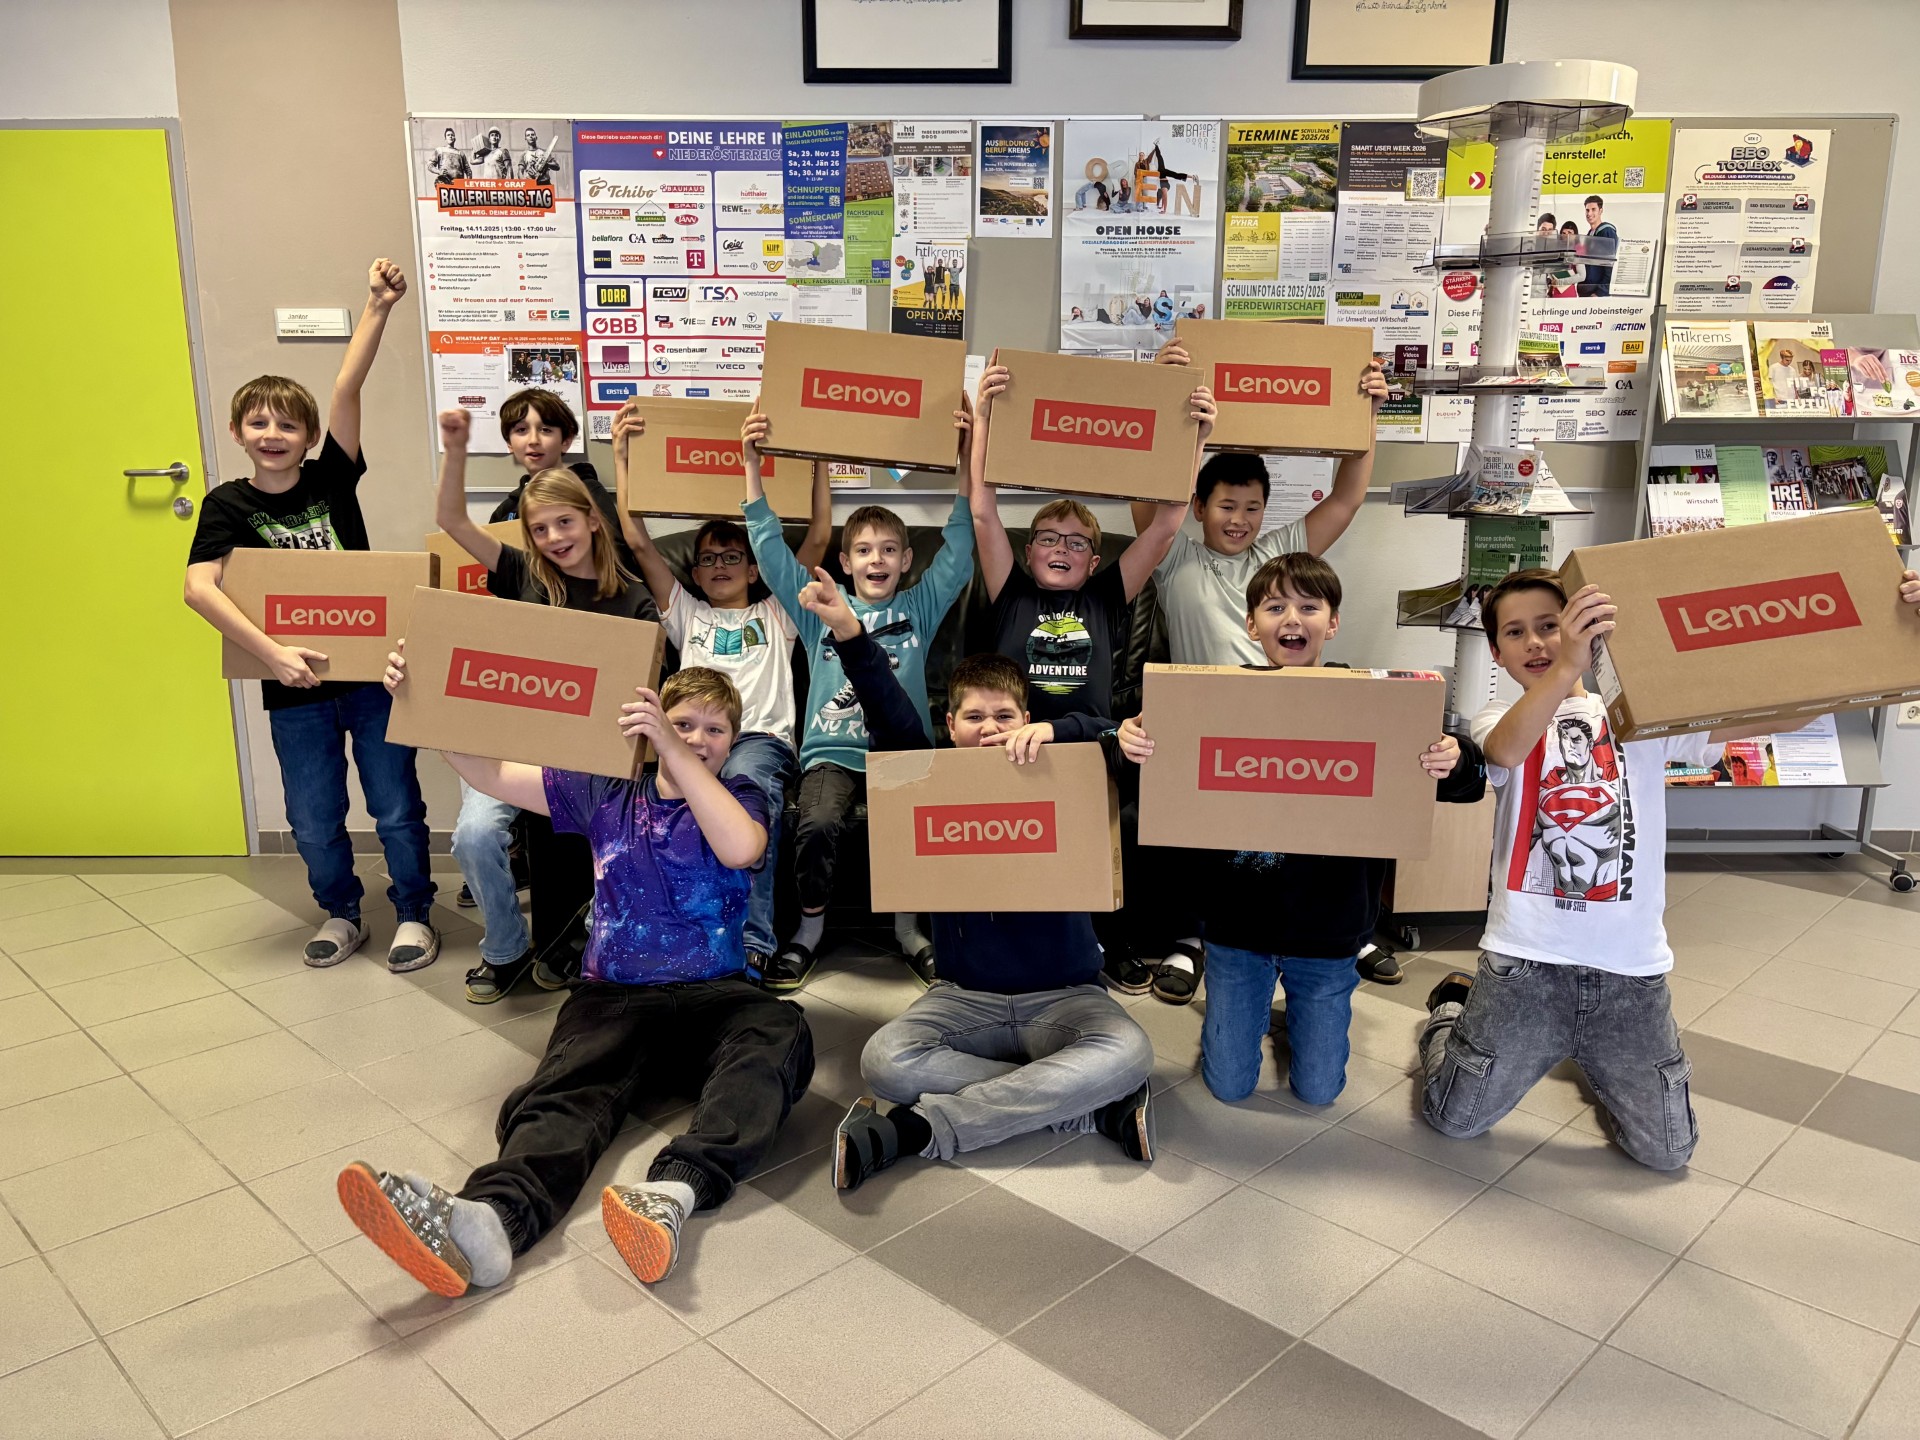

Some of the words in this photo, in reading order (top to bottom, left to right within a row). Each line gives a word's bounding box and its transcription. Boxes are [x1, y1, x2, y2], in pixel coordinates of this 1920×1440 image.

[669, 132, 712, 144] DEINE
[720, 132, 765, 144] LEHRE
[785, 129, 829, 140] EINLADUNG
[1238, 130, 1299, 141] TERMINE
[1731, 147, 1770, 160] BBO
[1717, 160, 1784, 172] TOOLBOX
[608, 185, 657, 199] Tchibo
[789, 212, 842, 224] SOMMERCAMP
[1096, 226, 1131, 235] OPEN
[1136, 226, 1181, 235] HOUSE
[916, 245, 964, 258] htlkrems
[655, 289, 685, 297] TGW
[1227, 285, 1285, 297] SCHULINFOTAGE
[1288, 284, 1325, 299] 2025/2026
[1227, 301, 1324, 311] PFERDEWIRTSCHAFT
[1532, 308, 1565, 317] Lehrlinge
[1567, 308, 1587, 316] und
[1589, 307, 1644, 317] Jobeinsteiger
[906, 310, 934, 320] OPEN
[937, 310, 962, 321] DAYS
[593, 317, 637, 334] ÖBB
[712, 316, 736, 326] EVN
[1671, 330, 1732, 343] htlkrems
[1899, 354, 1918, 364] hts
[1225, 372, 1320, 395] Lenovo
[813, 378, 910, 407] Lenovo
[1043, 409, 1144, 440] Lenovo
[1521, 544, 1549, 552] Zukunft
[276, 604, 376, 626] Lenovo
[1678, 593, 1837, 636] Lenovo
[1029, 664, 1088, 676] ADVENTURE
[460, 660, 581, 701] Lenovo
[1215, 749, 1358, 782] Lenovo
[926, 816, 1044, 843] Lenovo
[1555, 898, 1567, 909] MAN
[1567, 900, 1572, 910] OF
[1573, 900, 1587, 912] STEEL
